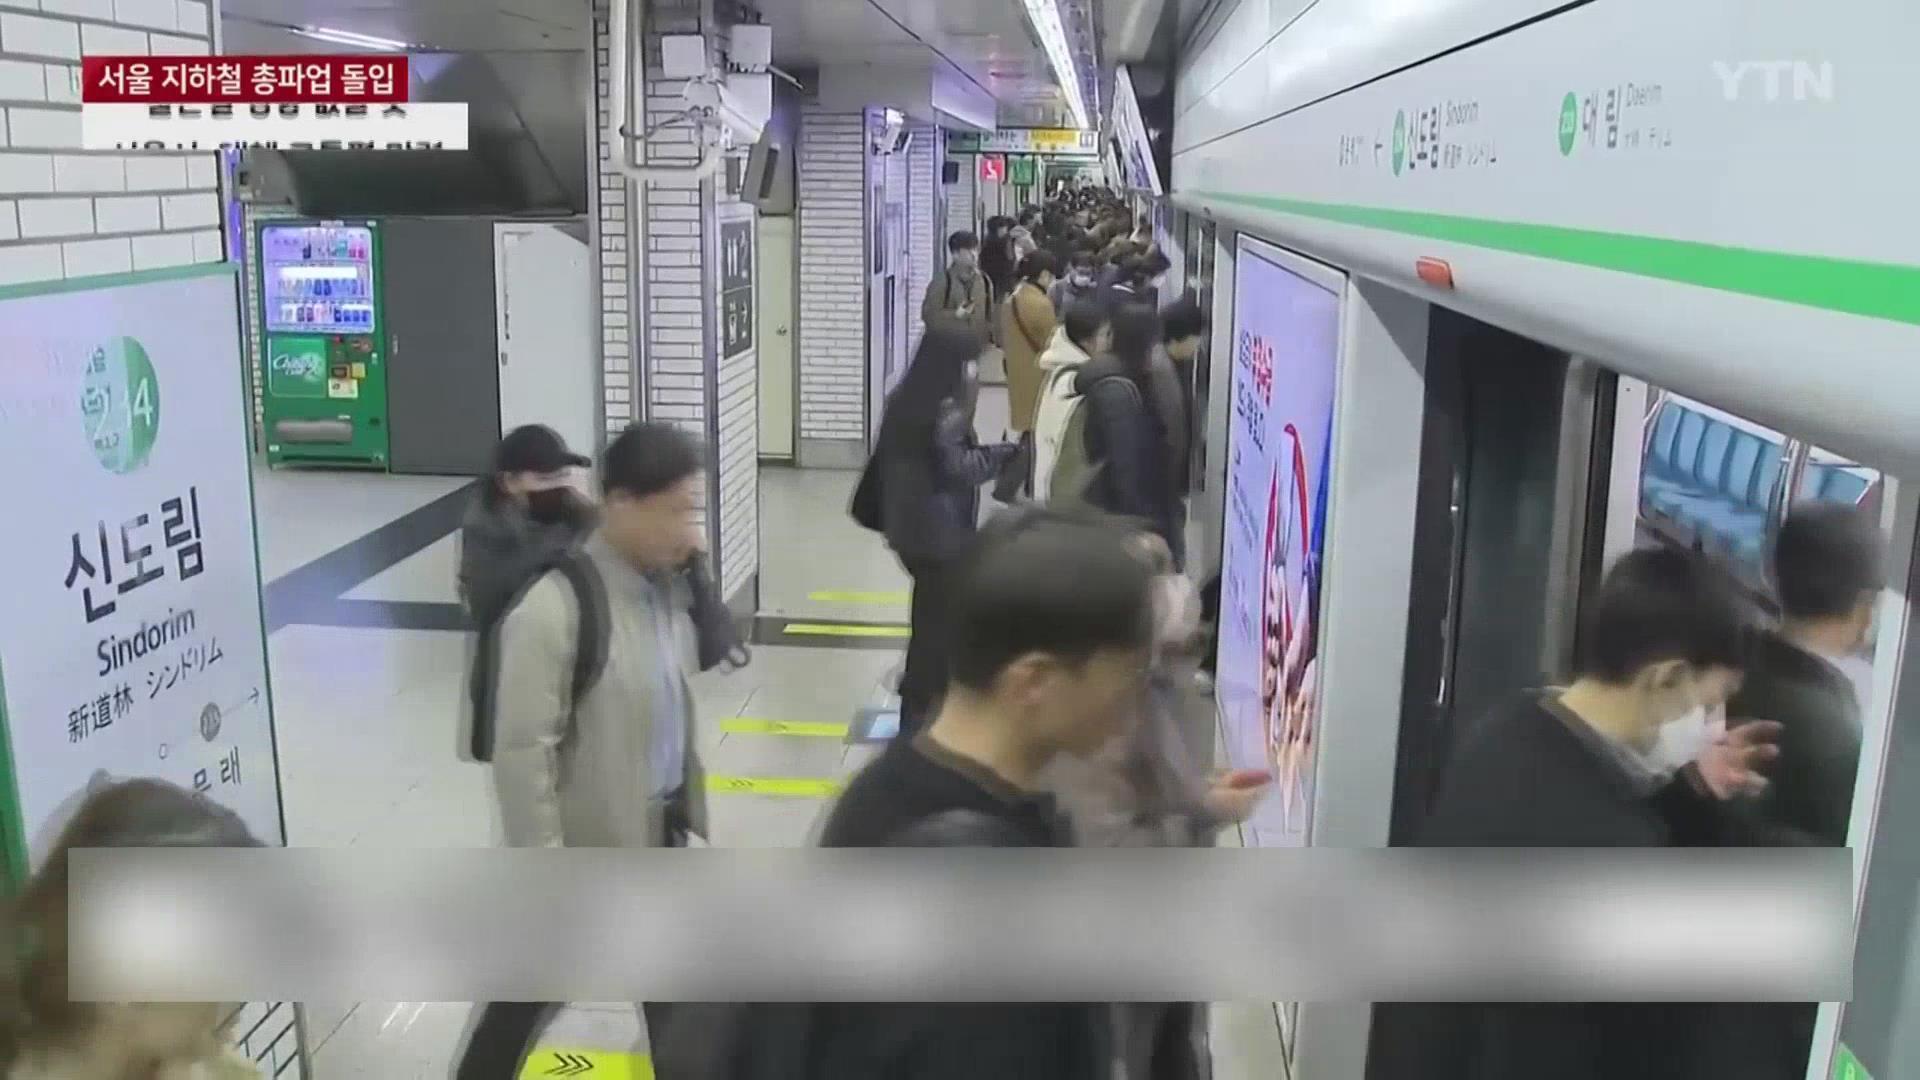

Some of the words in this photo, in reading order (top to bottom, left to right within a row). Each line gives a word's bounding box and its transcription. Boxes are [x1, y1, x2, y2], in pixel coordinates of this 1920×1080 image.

[1408, 102, 1442, 170] 신도림
[64, 486, 204, 623] 신도림
[97, 608, 196, 677] Sindorim
[68, 682, 134, 743] 新道林
[147, 636, 223, 699] シンドリム
